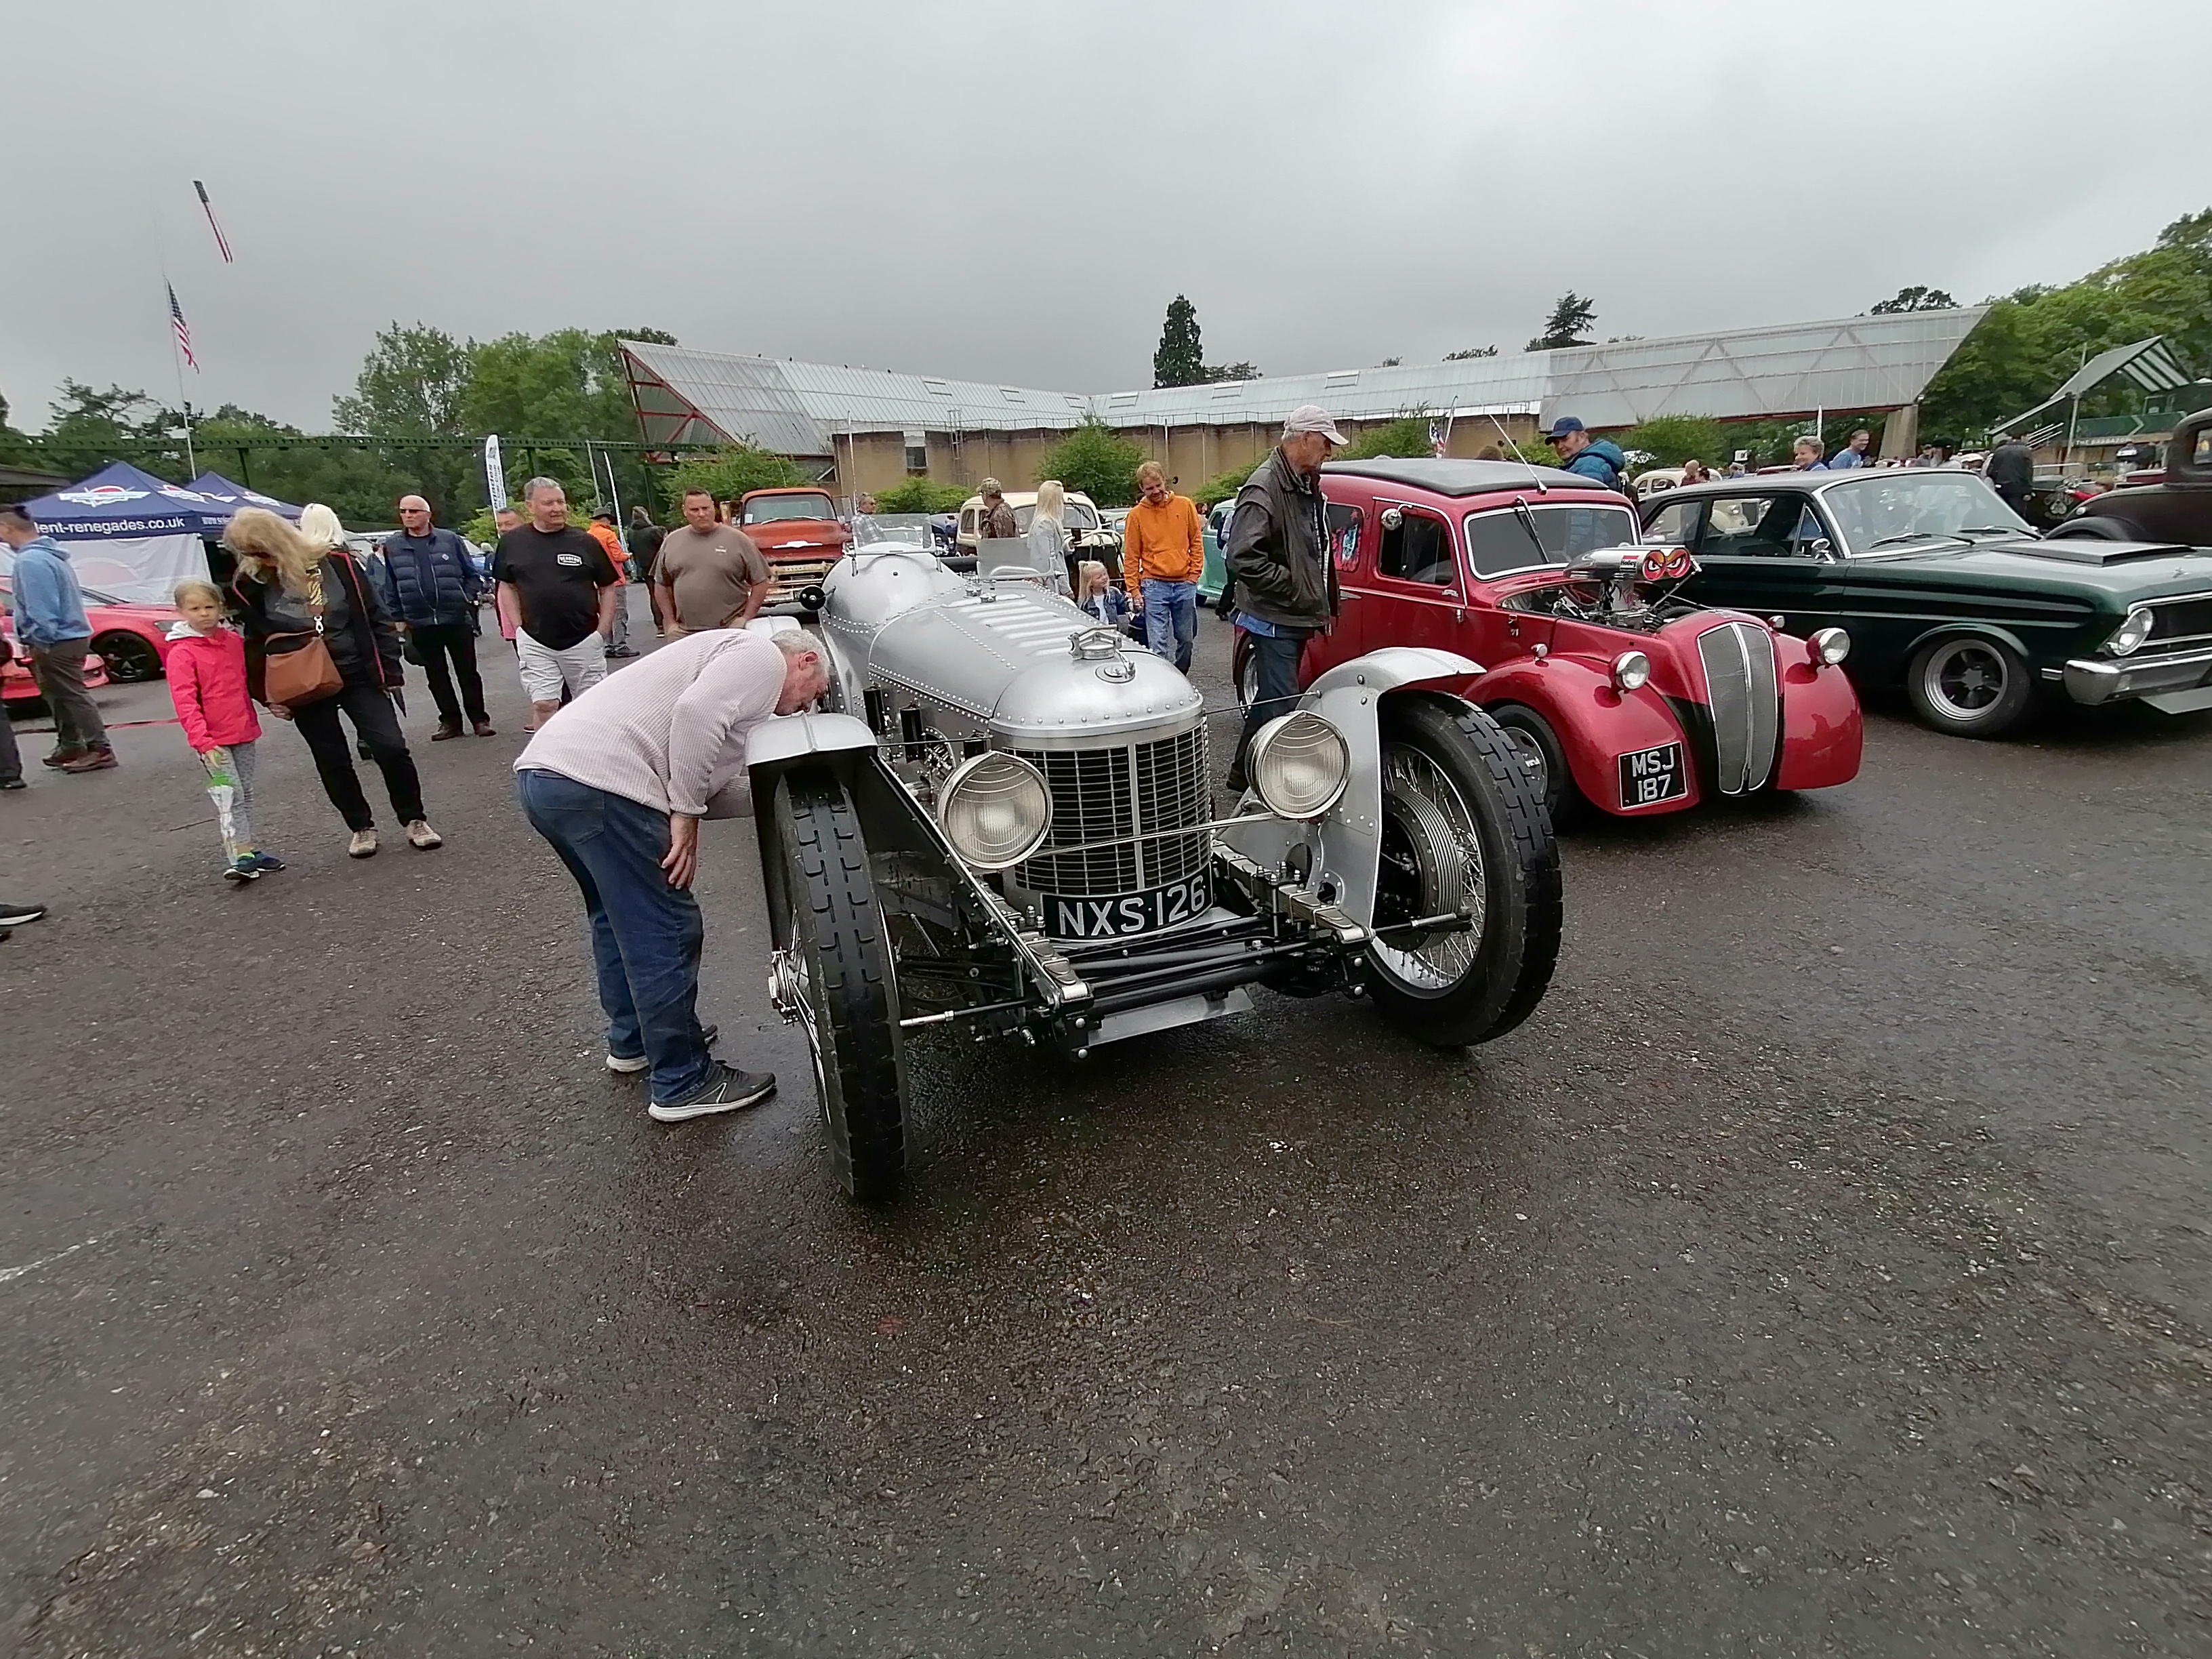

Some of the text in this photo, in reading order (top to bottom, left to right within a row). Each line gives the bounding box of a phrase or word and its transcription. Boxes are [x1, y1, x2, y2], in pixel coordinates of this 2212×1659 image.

[1620, 559, 1637, 568] Holley
[1632, 747, 1675, 777] MSJ
[1637, 774, 1671, 802] 187
[1058, 875, 1206, 937] NXS 126
